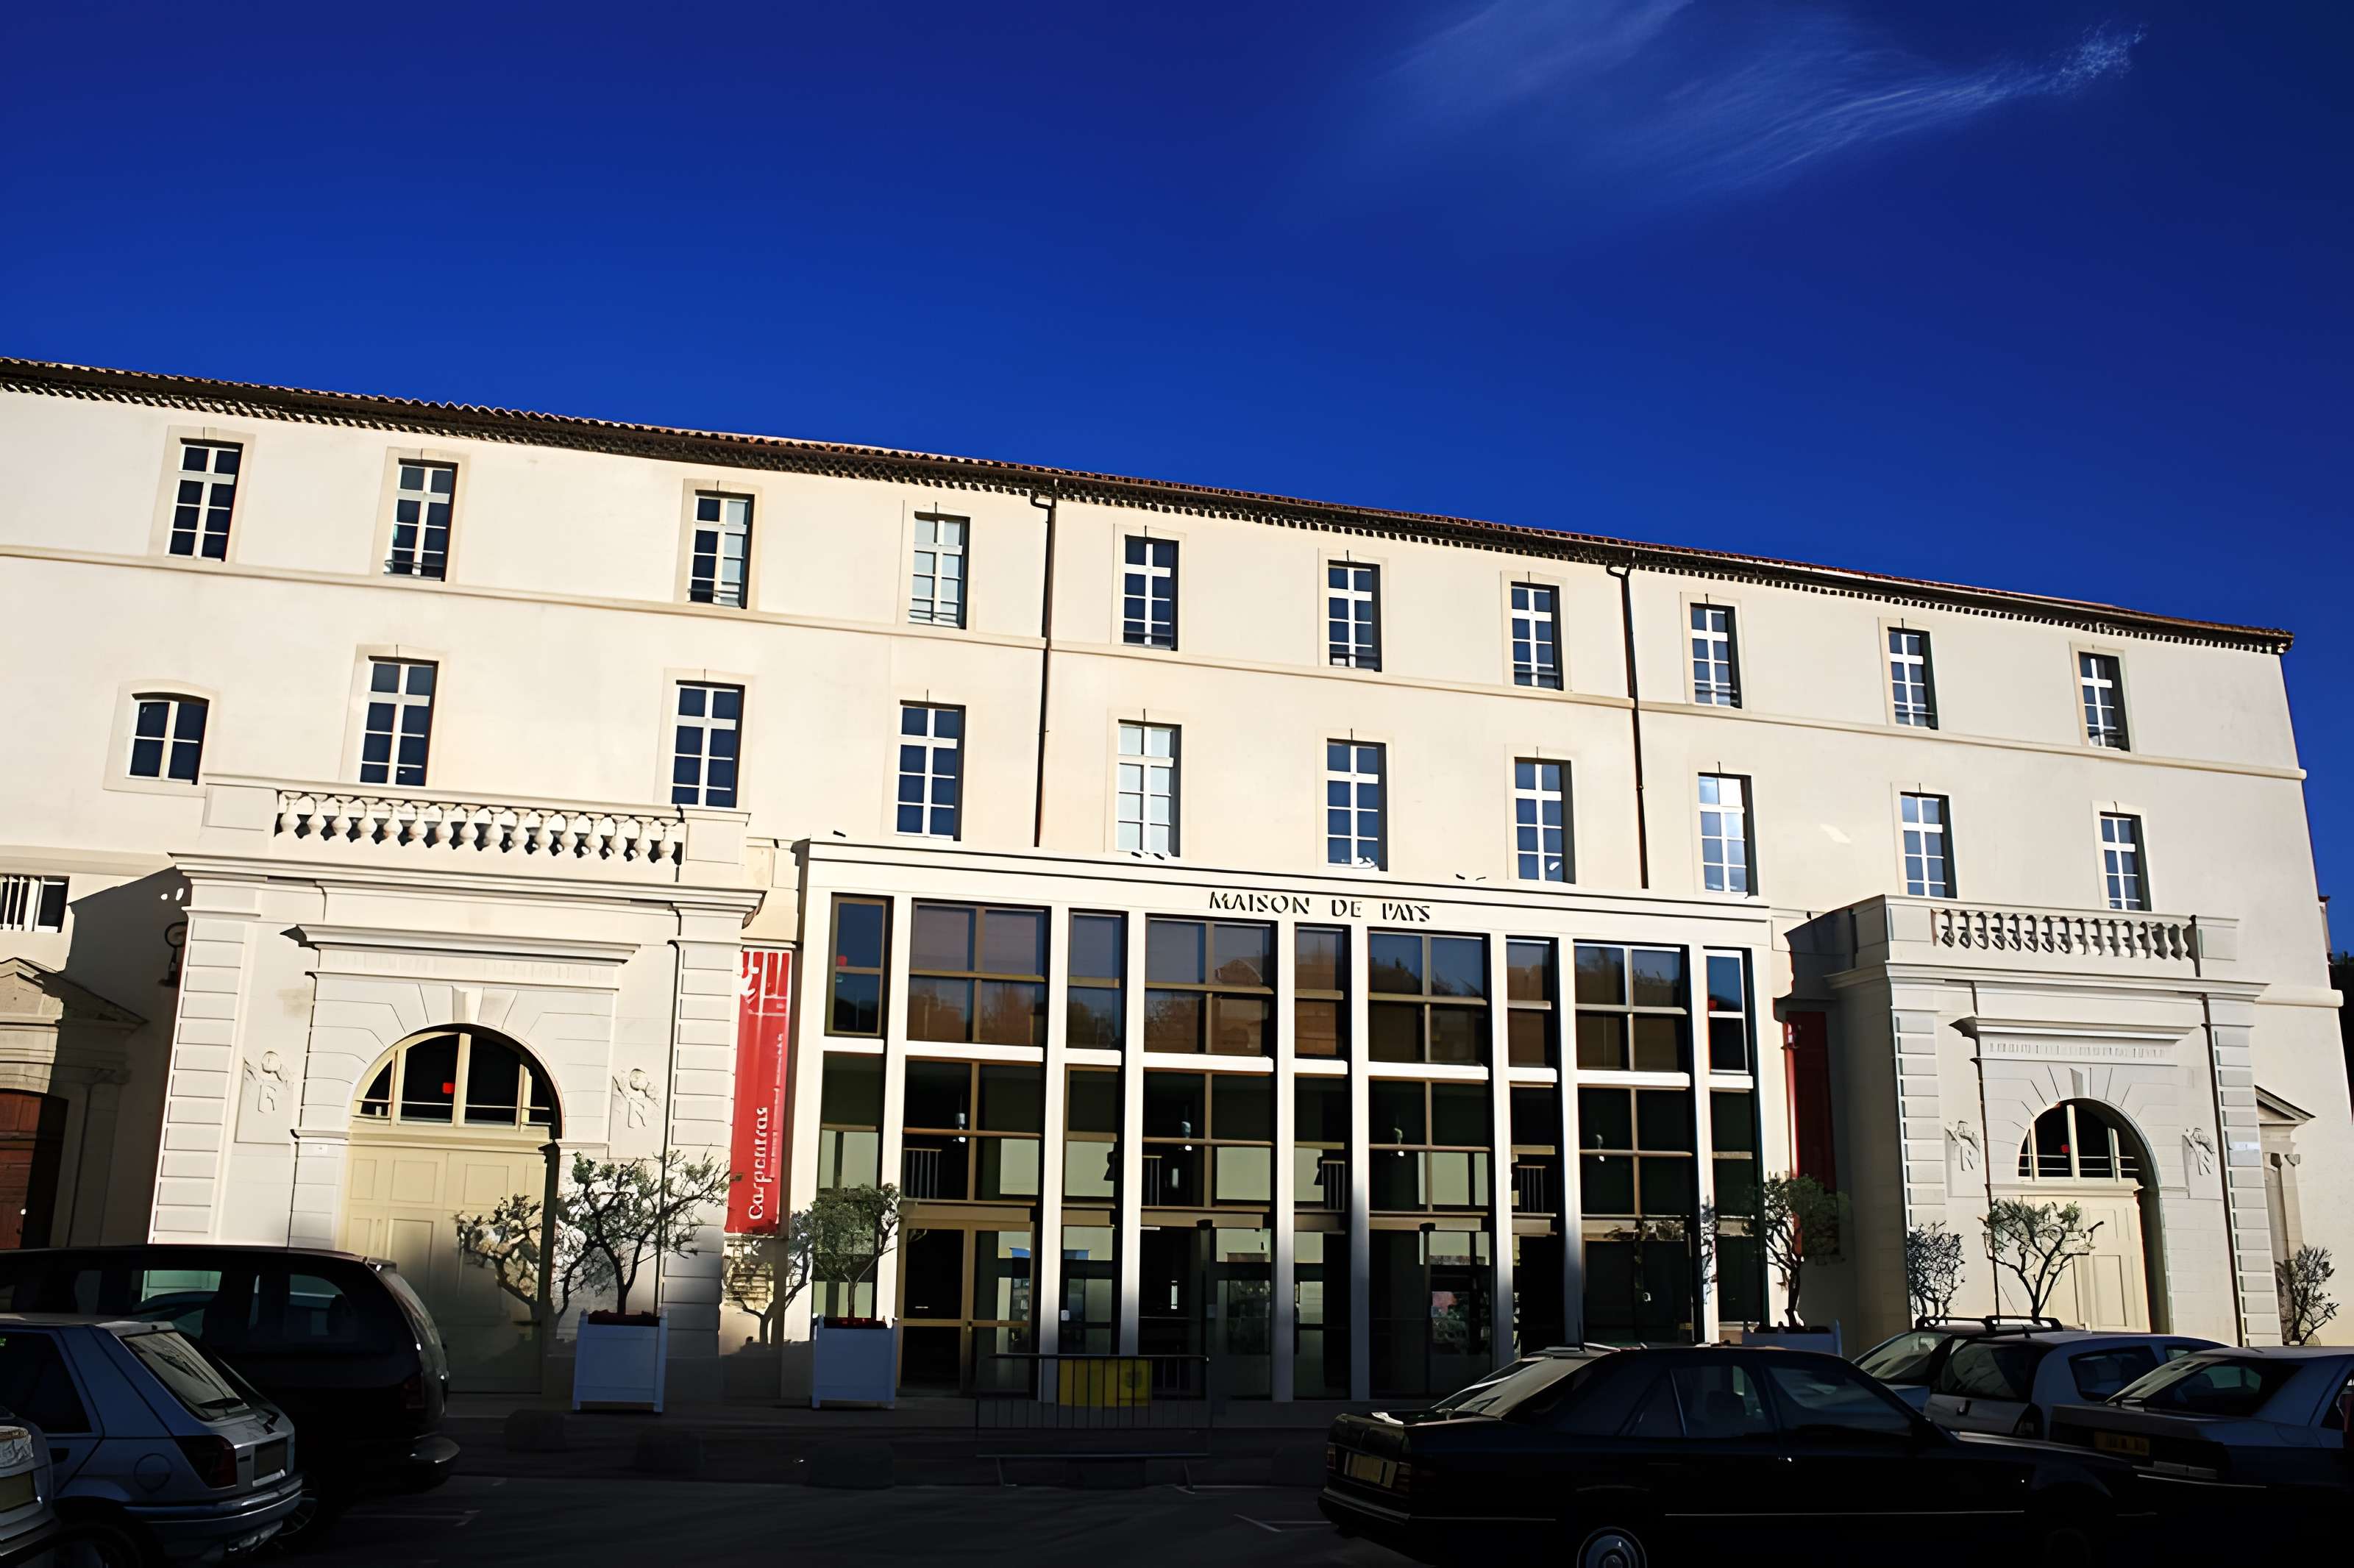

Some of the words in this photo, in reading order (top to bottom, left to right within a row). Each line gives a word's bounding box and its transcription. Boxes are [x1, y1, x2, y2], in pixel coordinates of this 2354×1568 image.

[1209, 891, 1310, 915] MAISON
[1331, 899, 1362, 918] DE
[1382, 902, 1431, 922] PAYS
[748, 1107, 772, 1219] Carpentras
